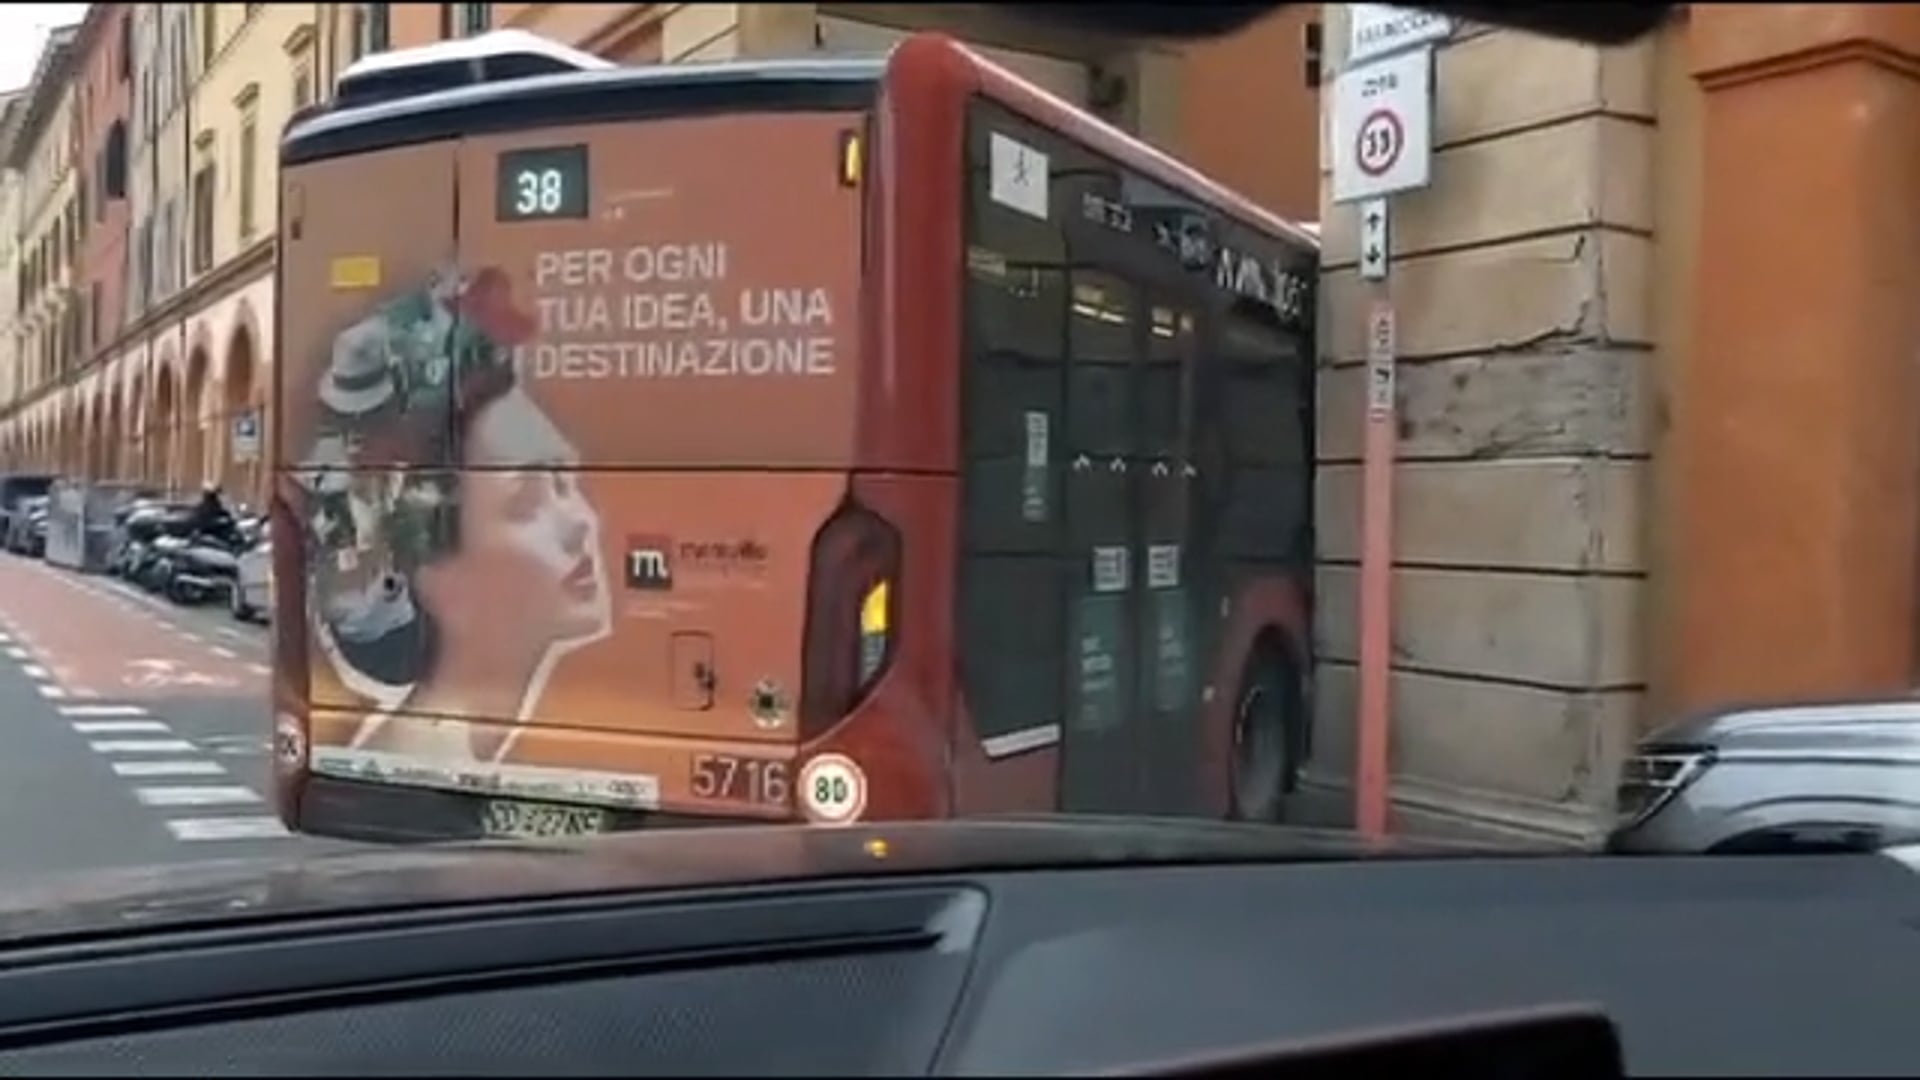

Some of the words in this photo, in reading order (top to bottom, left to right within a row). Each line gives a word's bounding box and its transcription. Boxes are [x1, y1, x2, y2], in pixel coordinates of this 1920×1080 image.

[516, 169, 562, 214] 38
[535, 249, 612, 286] PER
[623, 243, 727, 282] OGNI
[538, 295, 612, 332] TUA
[625, 293, 729, 332] IDEA,
[739, 287, 832, 326] UNA
[534, 338, 835, 379] DESTINAZIONE
[692, 753, 788, 802] 5716
